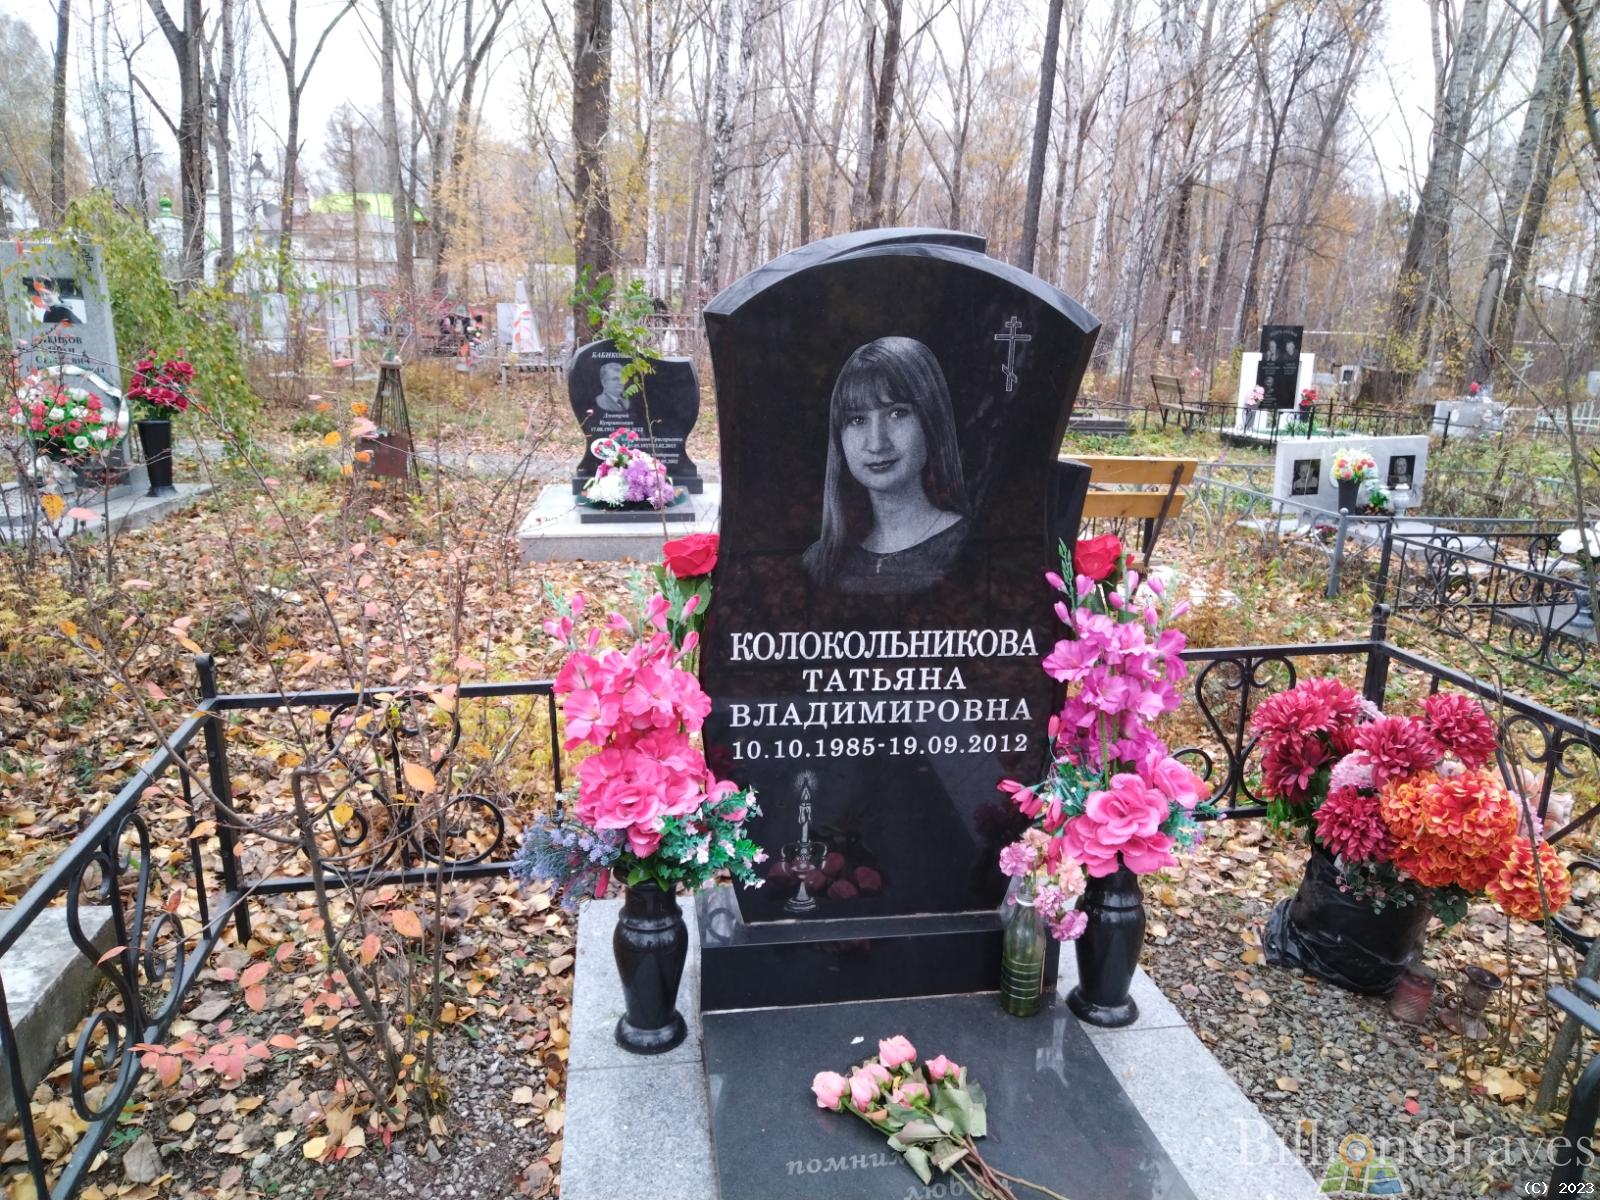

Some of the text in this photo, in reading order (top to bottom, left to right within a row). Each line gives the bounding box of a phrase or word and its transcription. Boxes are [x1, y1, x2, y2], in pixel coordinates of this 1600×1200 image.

[591, 351, 633, 360] БАБИКО
[730, 628, 1039, 661] КОЛОКОЛЬНИКОВА
[802, 666, 967, 693] ТАТЬЯНА
[729, 698, 1032, 730] ВЛАДИМИРОВНА
[732, 733, 1029, 760] 10.10.1985-19.09.2012
